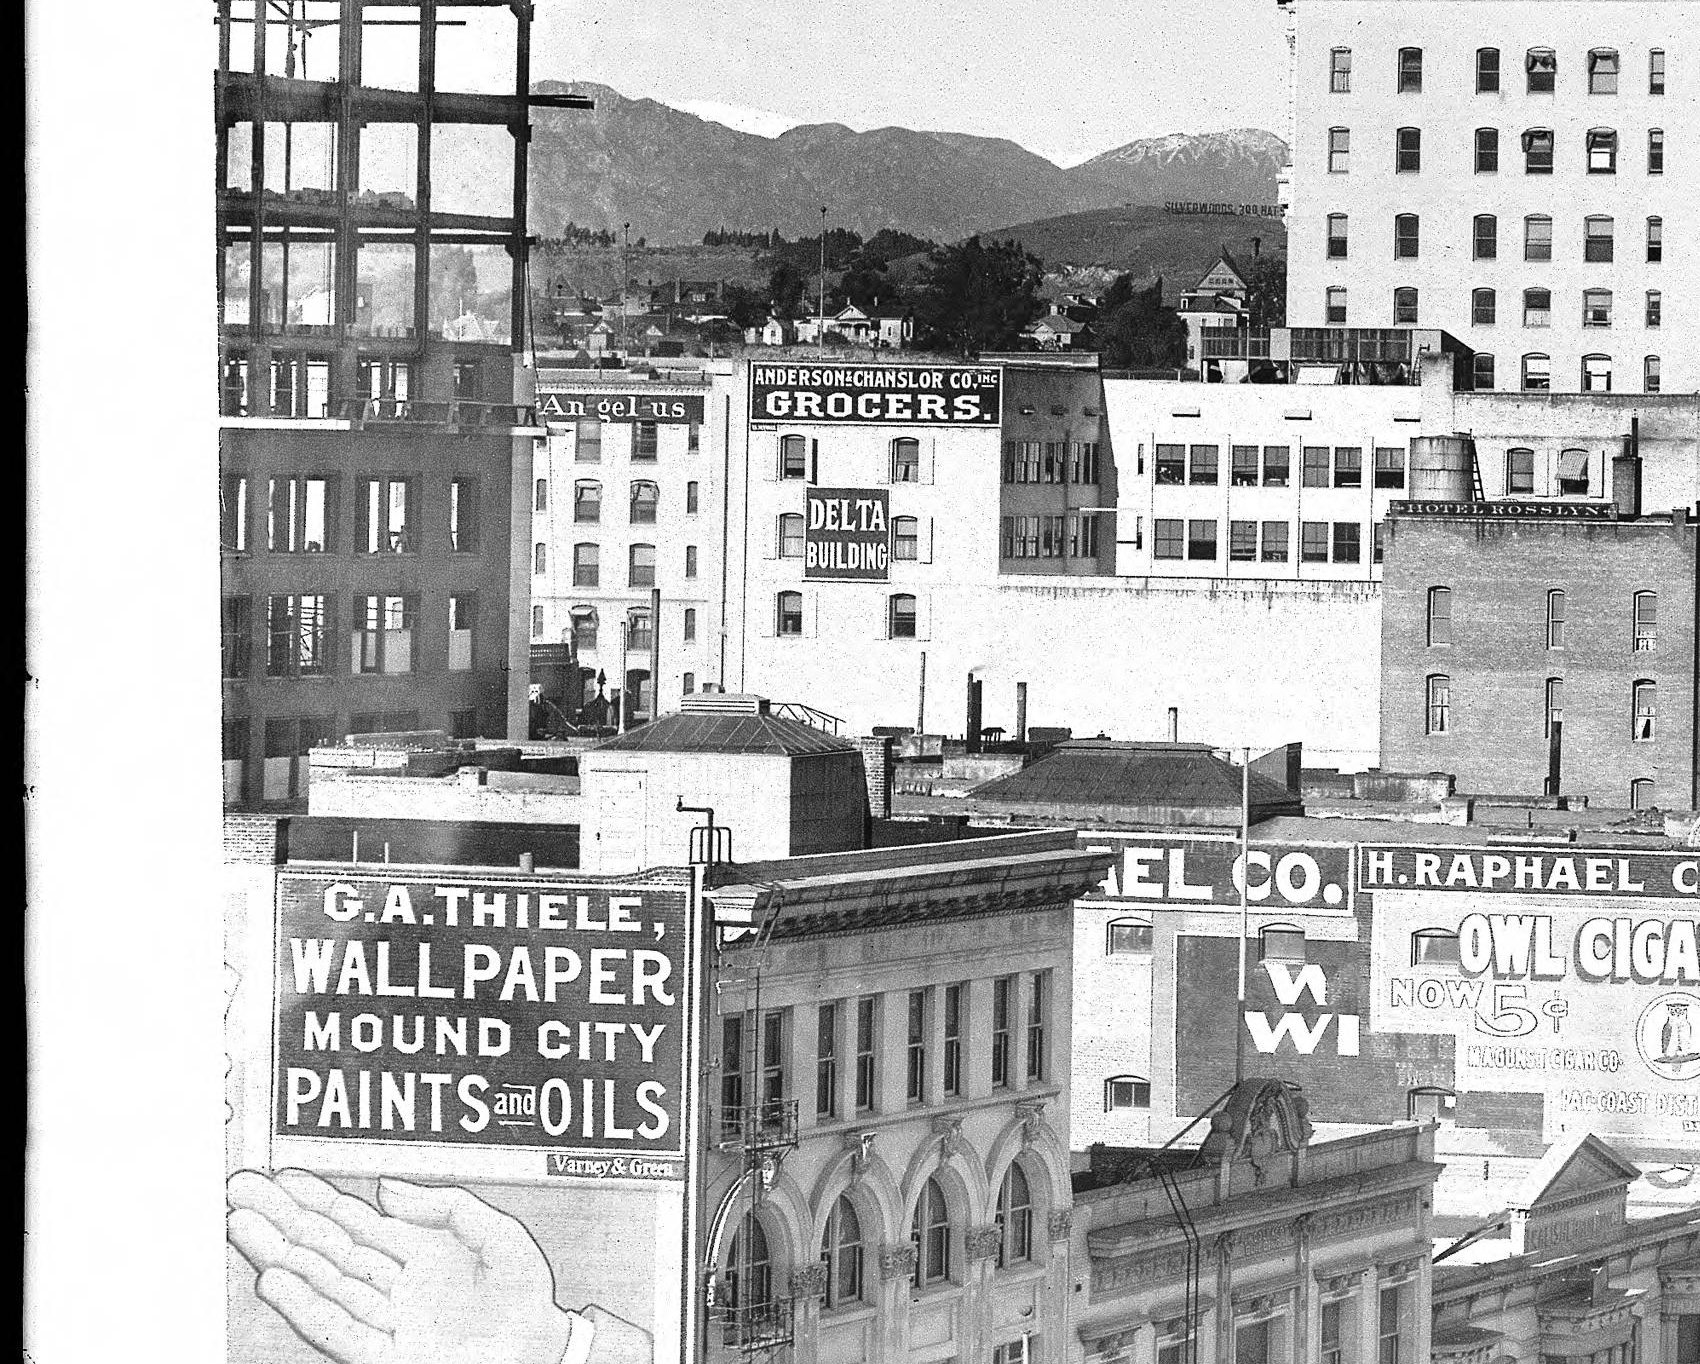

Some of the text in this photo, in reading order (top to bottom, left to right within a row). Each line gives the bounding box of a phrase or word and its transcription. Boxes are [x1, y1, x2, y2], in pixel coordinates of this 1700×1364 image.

[755, 368, 845, 388] ANDERSON
[853, 370, 942, 389] CHANSLOR
[766, 392, 992, 420] GROCERS.
[809, 498, 886, 533] DELTA
[1407, 503, 1600, 516] HOTEL ROSSLYN
[806, 543, 888, 571] BUILDING
[1232, 851, 1344, 904] CO.
[1458, 913, 1566, 981] OWL
[463, 944, 675, 1006] PAPER
[1391, 979, 1482, 1010] NOW
[303, 1011, 666, 1062] MOUND CITY
[1550, 1048, 1595, 1071] CIGAR
[286, 1067, 670, 1140] PAINTS and OILS
[629, 1160, 674, 1178] Green
